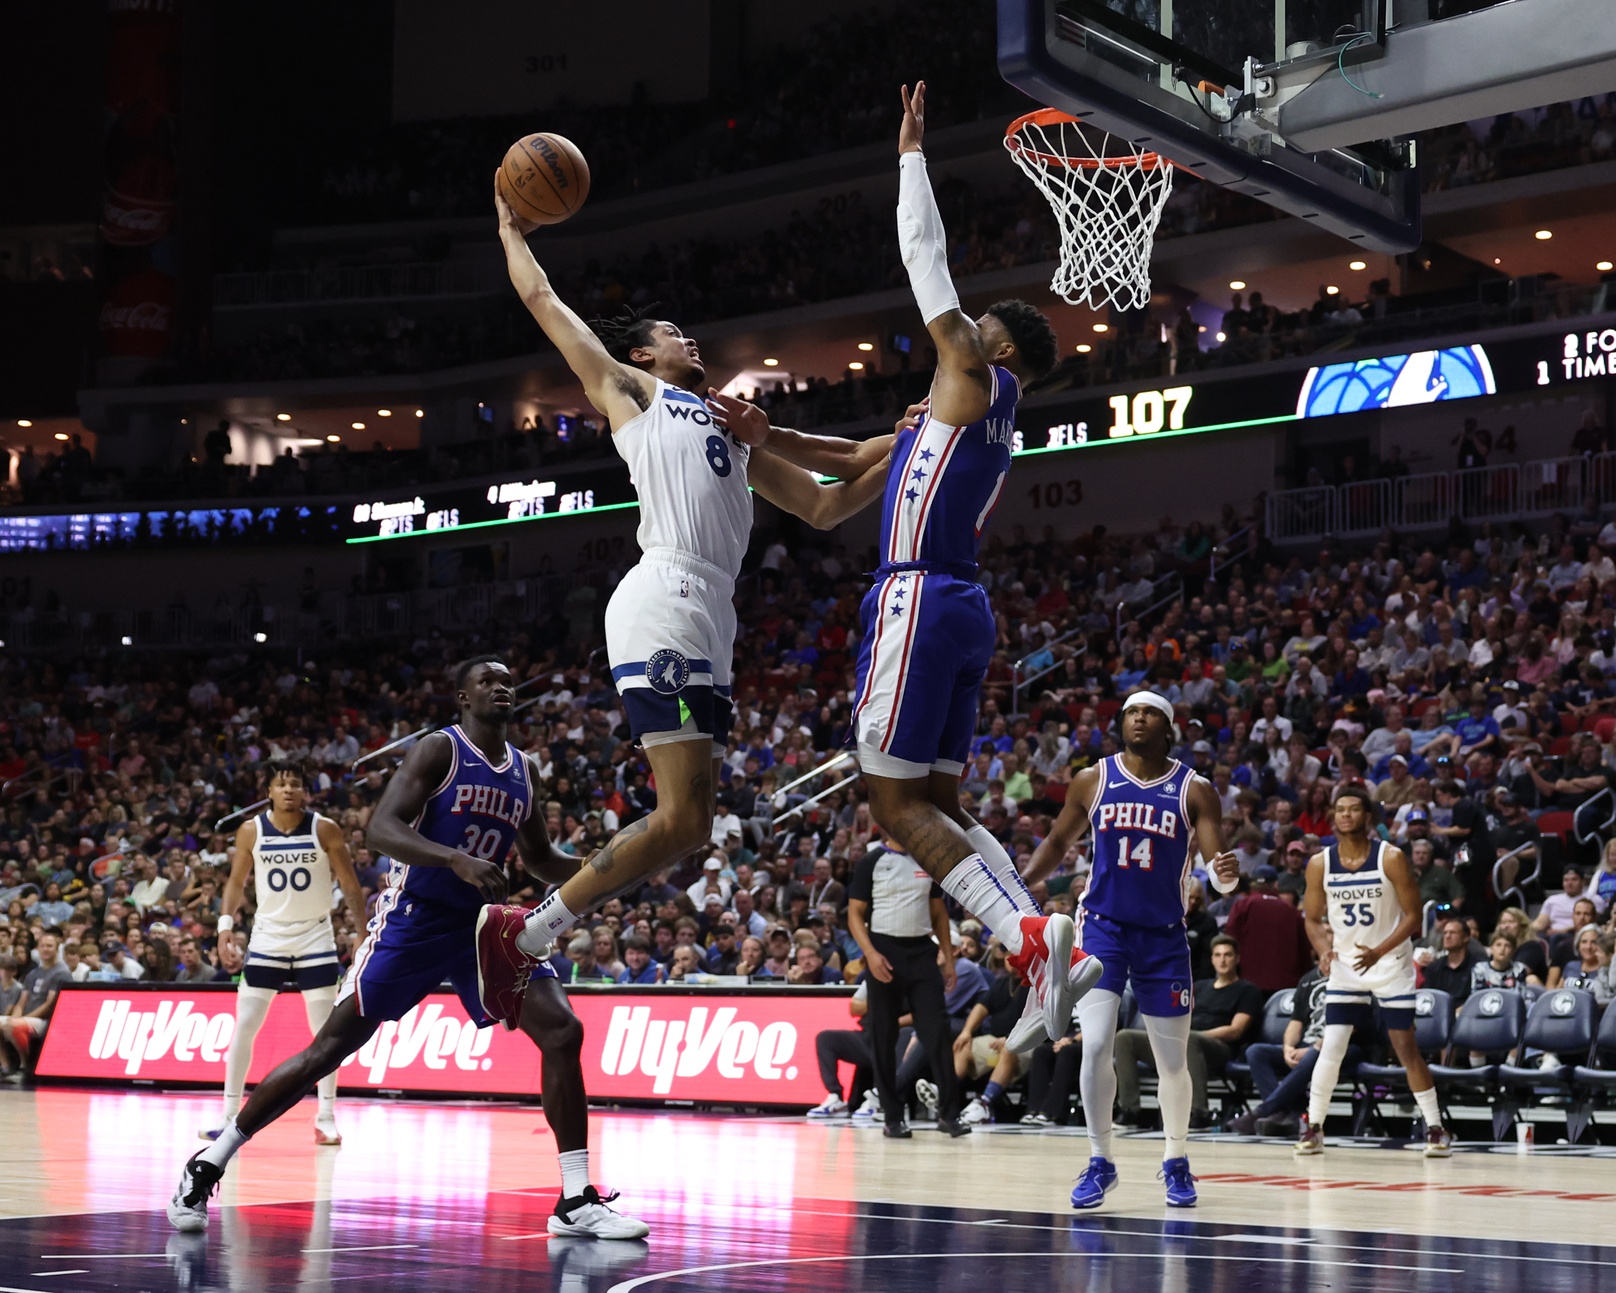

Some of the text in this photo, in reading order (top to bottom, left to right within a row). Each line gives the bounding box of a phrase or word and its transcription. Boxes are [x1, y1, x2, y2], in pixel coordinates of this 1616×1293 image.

[526, 54, 567, 73] 301
[530, 137, 569, 189] Wilson
[1564, 333, 1579, 358] 2
[1537, 361, 1550, 385] 1
[1109, 386, 1192, 438] 107
[706, 435, 731, 477] 8
[1028, 479, 1084, 509] 103
[451, 785, 525, 830] PHILA
[1098, 803, 1178, 838] PHILA
[457, 824, 504, 860] 30
[1117, 836, 1153, 871] 14
[260, 853, 317, 864] WOLVES
[267, 867, 312, 892] 00
[1330, 888, 1383, 900] WOLVES
[1341, 903, 1375, 927] 35
[1171, 989, 1190, 1007] 76
